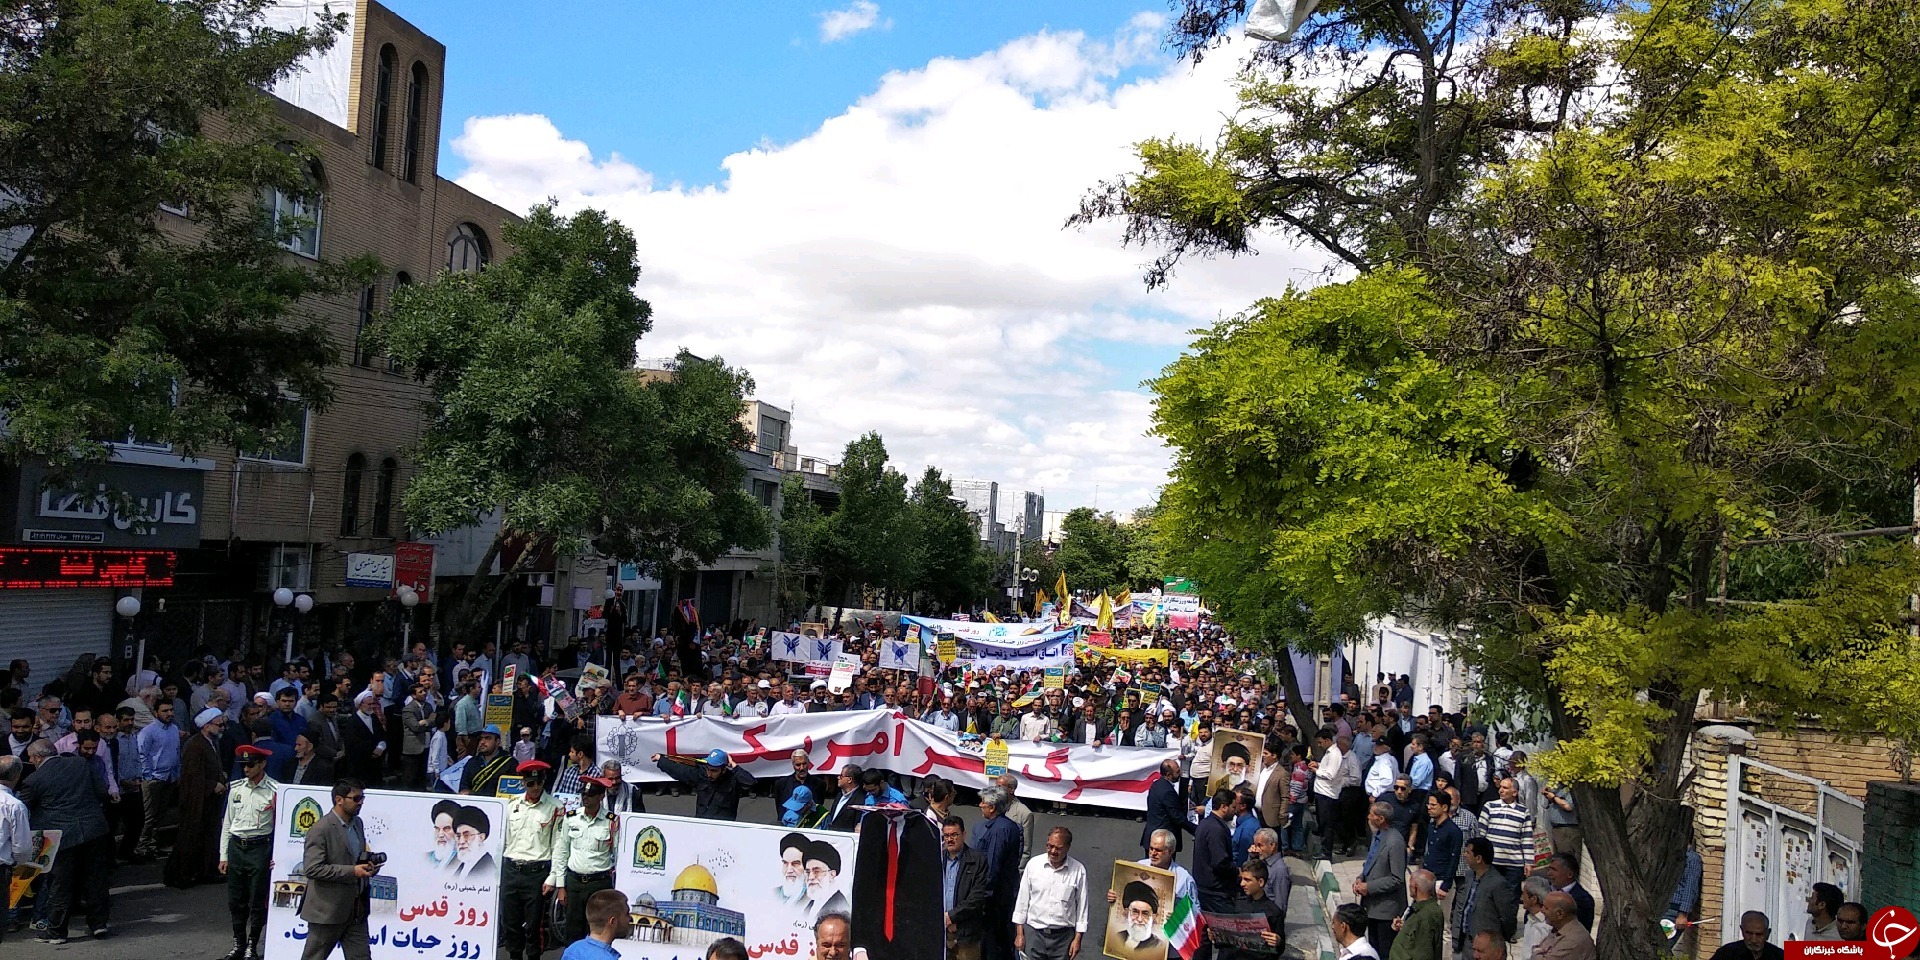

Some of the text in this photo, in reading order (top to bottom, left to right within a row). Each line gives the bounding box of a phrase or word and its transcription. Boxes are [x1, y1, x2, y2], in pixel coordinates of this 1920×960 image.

[114, 492, 196, 535] کابین
[979, 647, 1059, 660] اتاق اصناف زنجان
[1022, 747, 1161, 800] مرگ
[459, 884, 476, 893] خمینی
[477, 885, 491, 894] امام
[399, 895, 489, 927] روز قدس
[392, 929, 442, 952] حیات
[445, 934, 481, 960] روز
[747, 932, 799, 959] قدس
